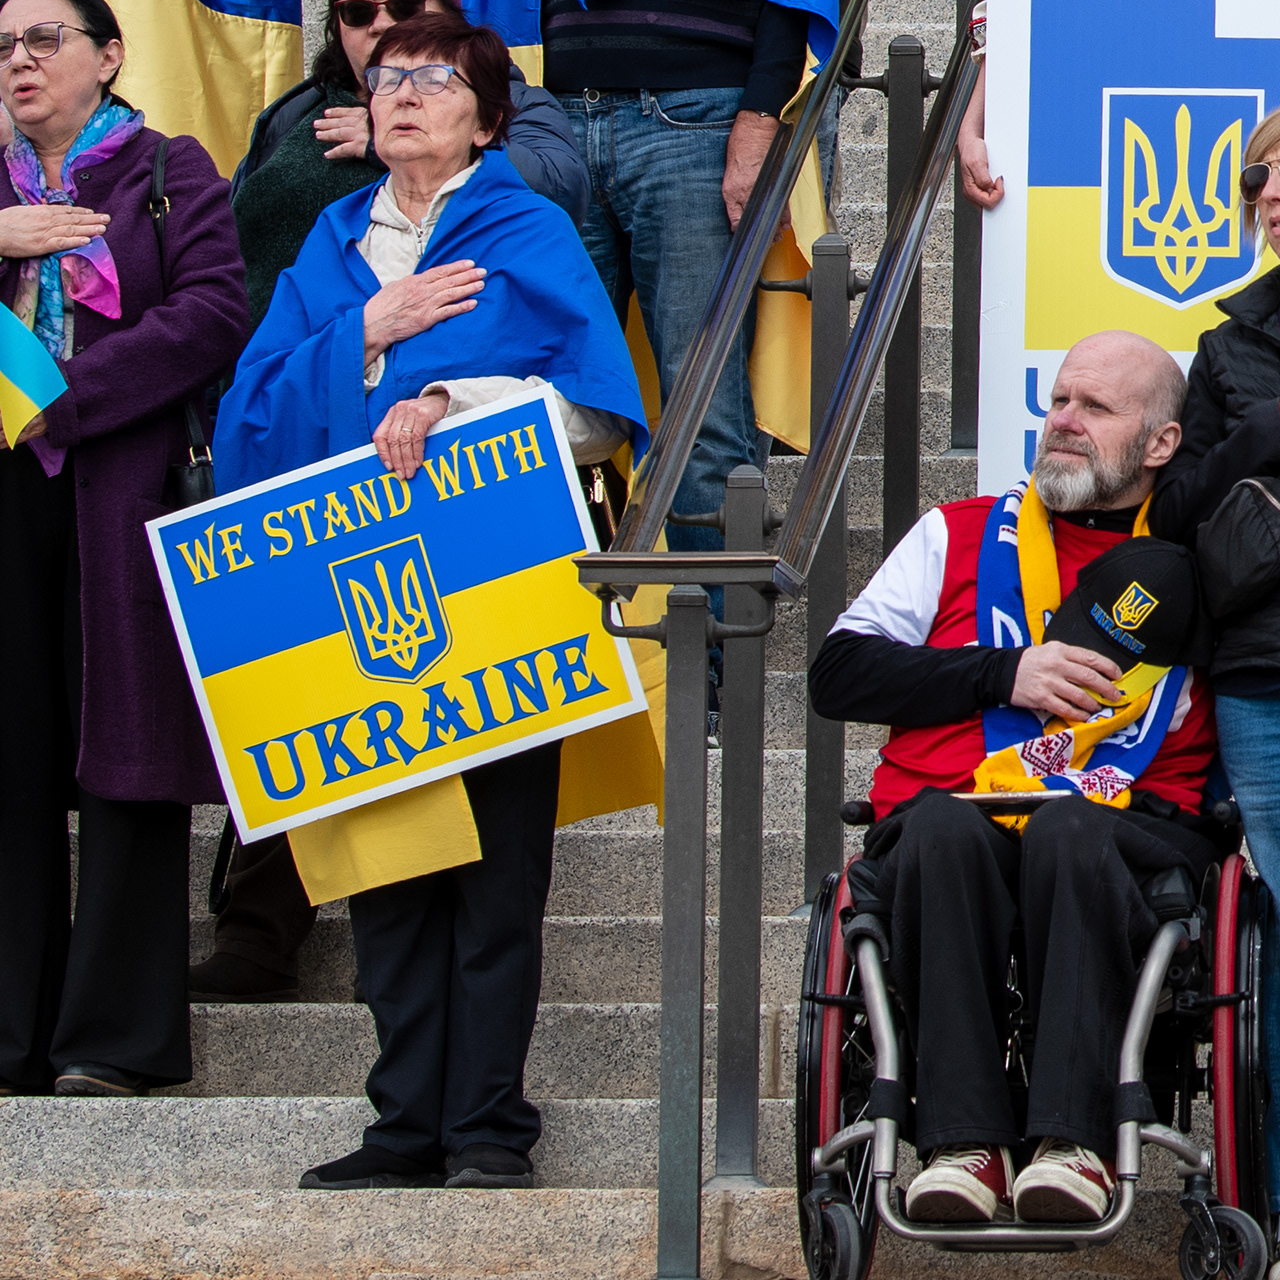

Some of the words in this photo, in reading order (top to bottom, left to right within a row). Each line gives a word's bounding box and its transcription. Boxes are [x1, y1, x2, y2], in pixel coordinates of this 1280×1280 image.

[176, 519, 255, 586] WE
[262, 472, 412, 559] STAND
[422, 424, 547, 502] WITH
[1090, 602, 1147, 655] UKRAINE
[243, 632, 610, 801] UKRAINE
